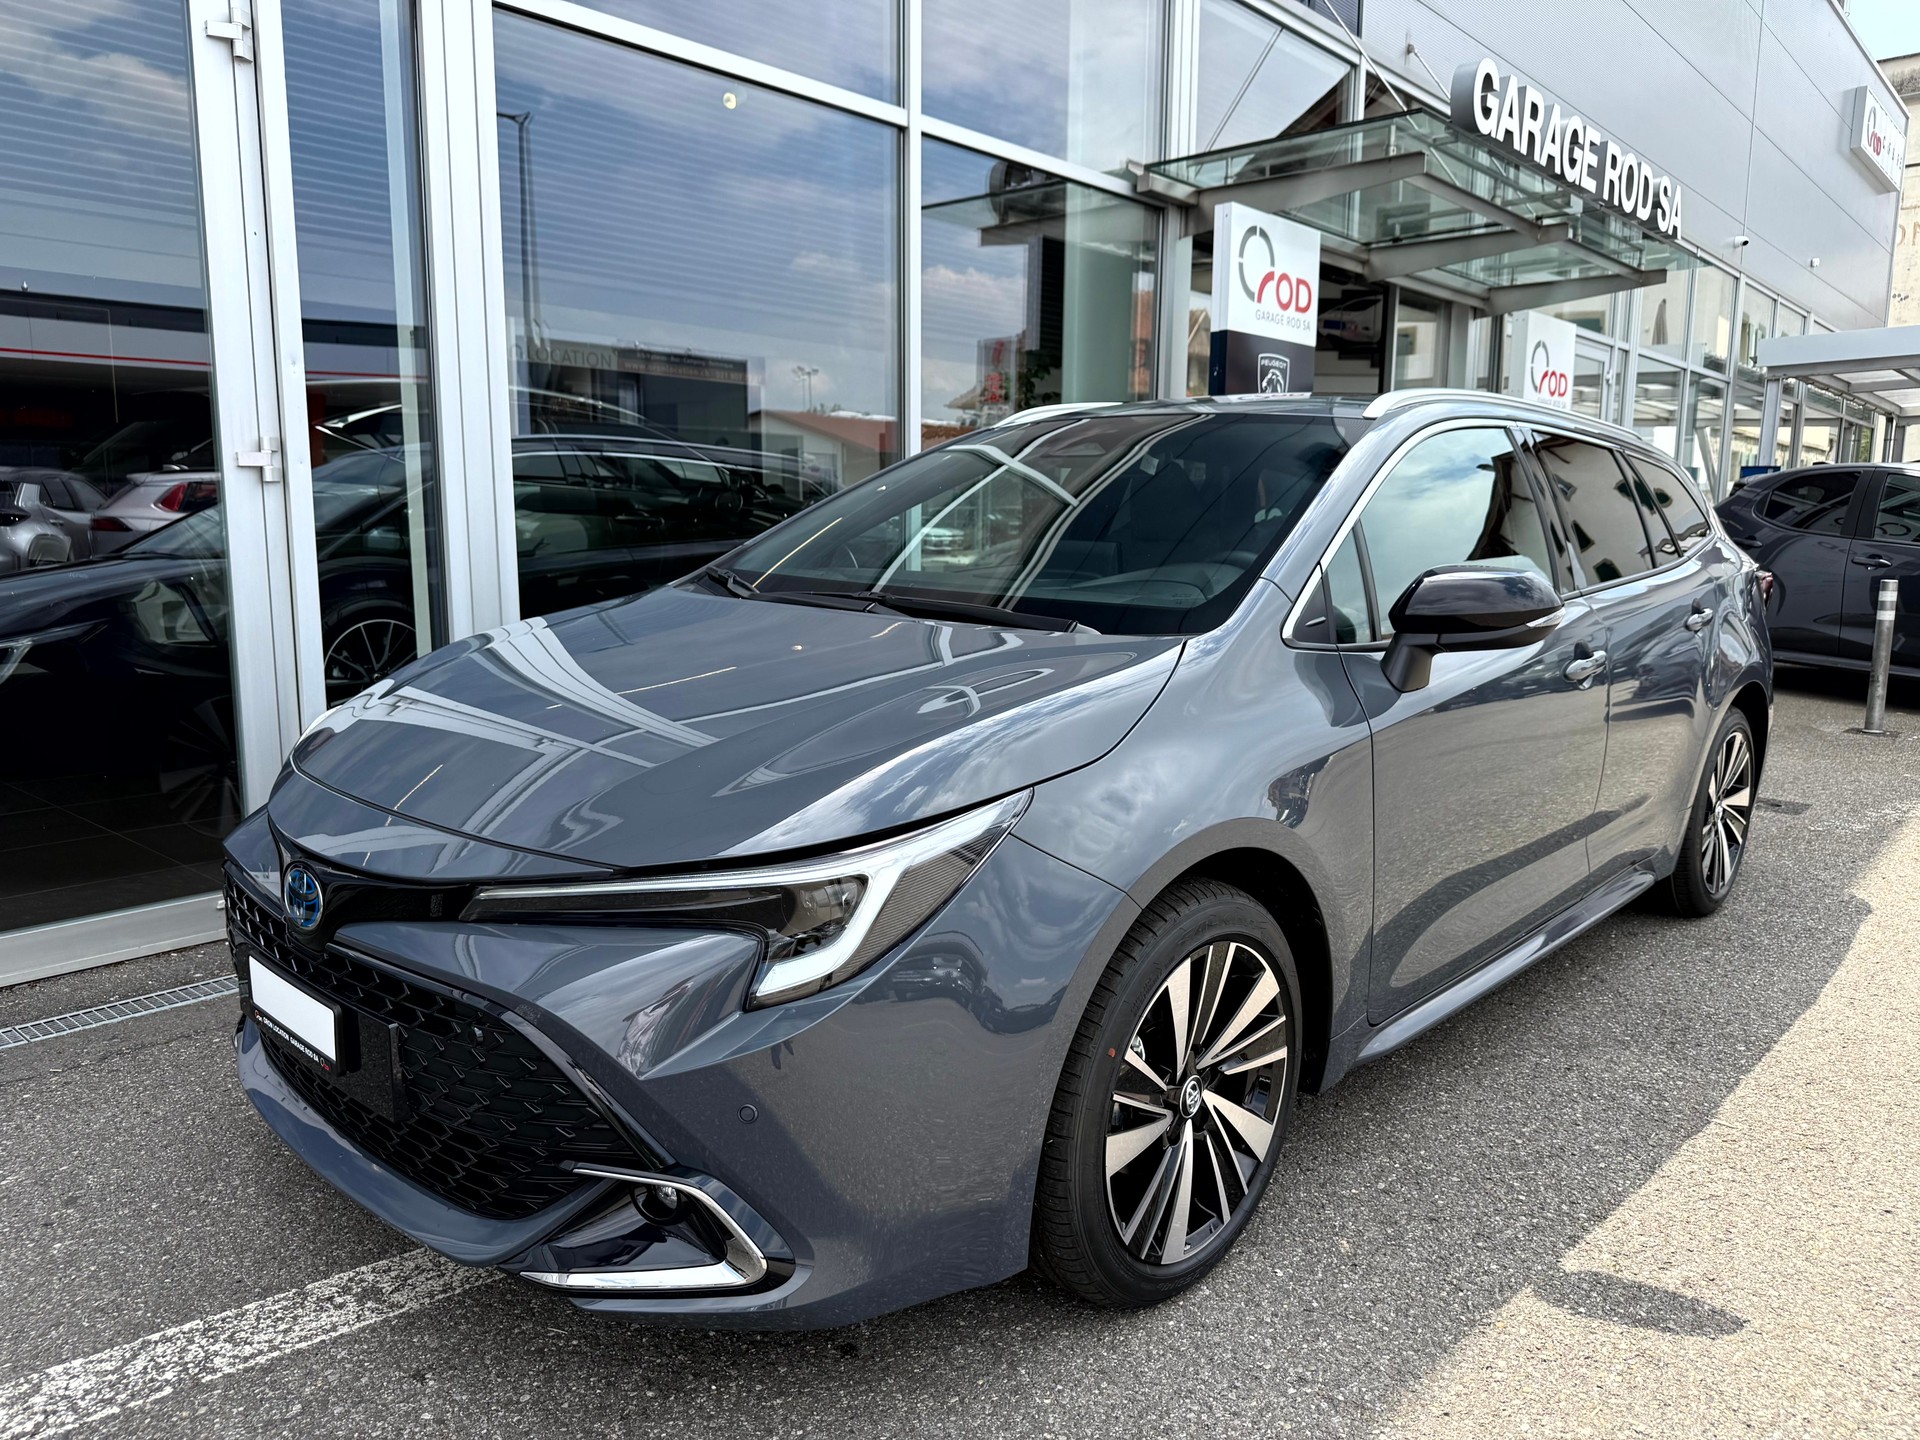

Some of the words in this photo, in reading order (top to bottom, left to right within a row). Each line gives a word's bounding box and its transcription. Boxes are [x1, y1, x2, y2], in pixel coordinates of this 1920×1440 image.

[1473, 57, 1602, 194] GARAGE
[1603, 139, 1654, 222] ROD
[1657, 175, 1683, 240] SA
[1255, 309, 1285, 327] GARAGE
[1286, 315, 1301, 329] ROD
[1302, 318, 1311, 331] SA
[528, 344, 612, 369] LOCATION
[1260, 358, 1287, 370] PEUGEOT
